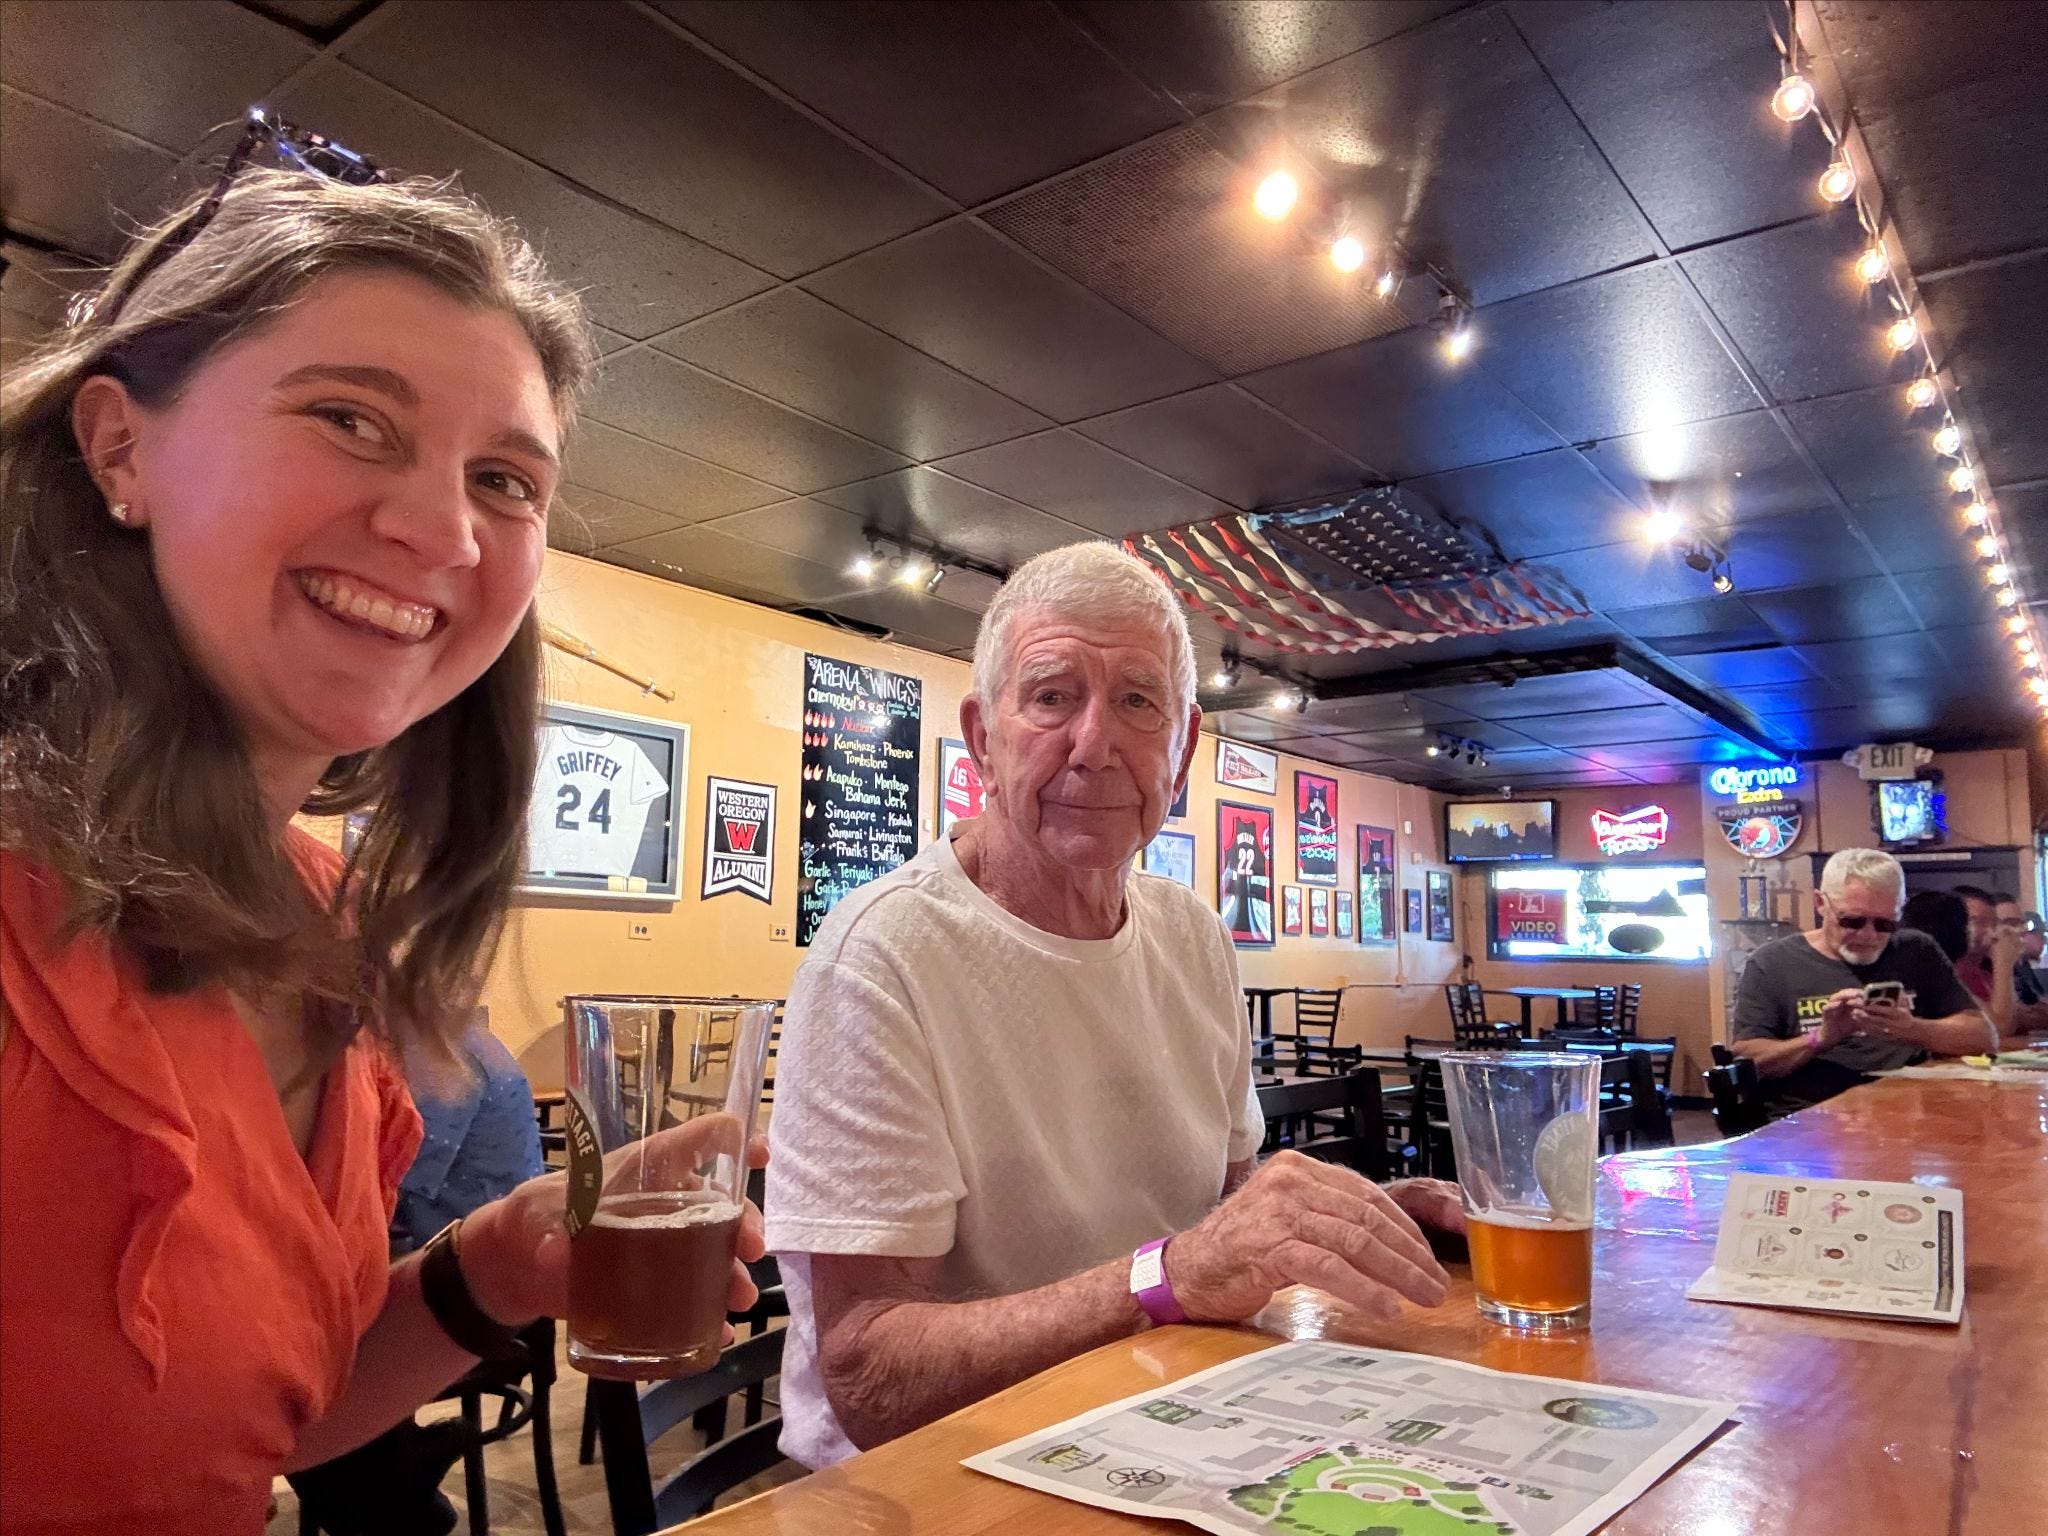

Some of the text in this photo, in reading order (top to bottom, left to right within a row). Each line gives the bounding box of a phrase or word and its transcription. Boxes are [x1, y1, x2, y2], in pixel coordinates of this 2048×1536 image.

[812, 659, 916, 706] ARENA WINGS
[844, 750, 888, 769] Tombstone
[883, 741, 914, 759] Phoenix
[1871, 746, 1905, 768] EXIT
[557, 751, 622, 781] GRIFFEY
[952, 765, 968, 787] 16
[826, 765, 909, 795] Acapulco Montego
[1710, 766, 1796, 794] Corona
[718, 790, 768, 809] WESTERN
[845, 786, 907, 810] Bahama Jerk
[1737, 787, 1783, 804] Extra
[556, 784, 612, 834] 24
[718, 803, 766, 821] OREGON
[824, 800, 913, 827] Singapore Kodiak
[1718, 804, 1796, 817] PROUD PARTNER
[724, 818, 760, 853] W
[828, 823, 913, 846] Samurai Livingston
[836, 841, 868, 858] Frank's
[871, 843, 905, 865] Buffalo
[1237, 848, 1255, 875] 22
[713, 860, 765, 884] ALUMNI
[804, 860, 832, 878] Garlic
[837, 863, 874, 886] Teriyaki
[814, 879, 840, 895] Garlic
[803, 894, 827, 913] Honey
[1511, 921, 1556, 932] VIDEO
